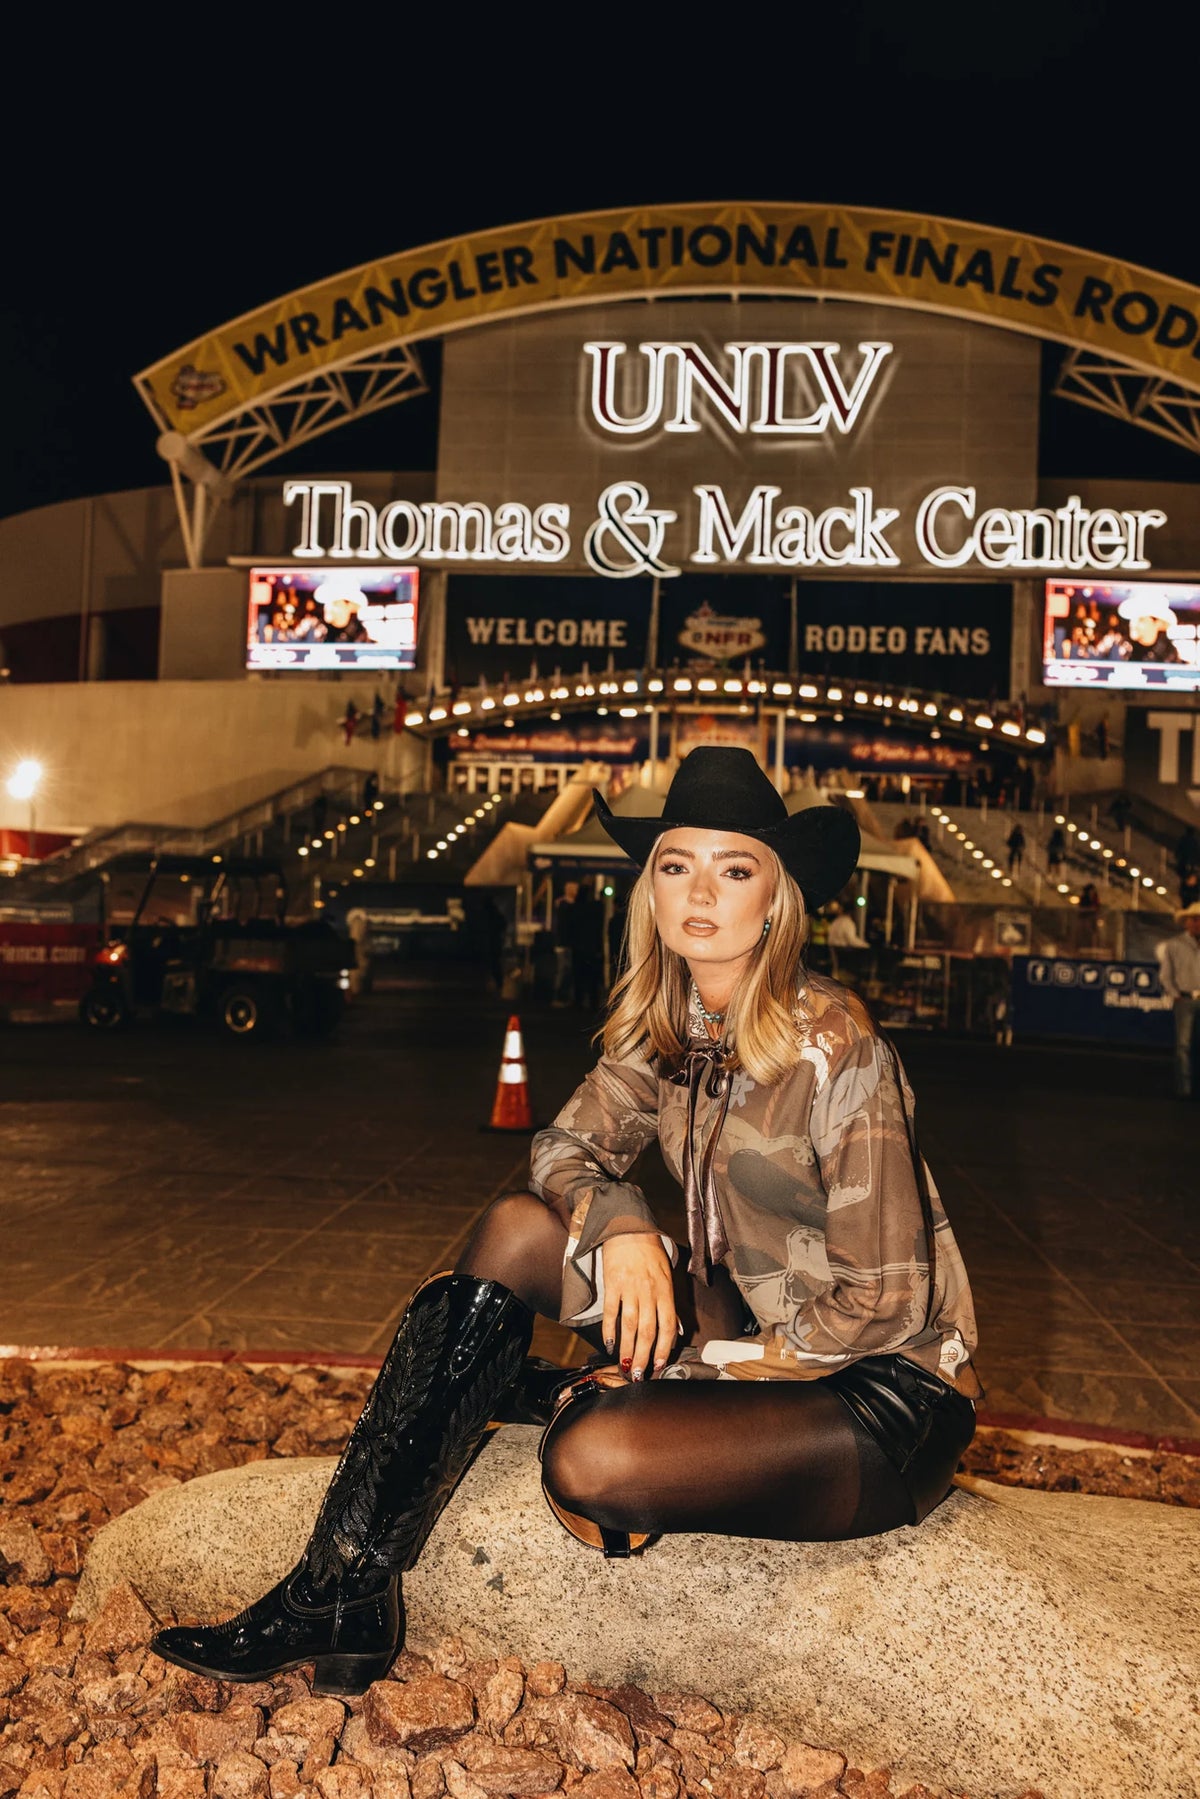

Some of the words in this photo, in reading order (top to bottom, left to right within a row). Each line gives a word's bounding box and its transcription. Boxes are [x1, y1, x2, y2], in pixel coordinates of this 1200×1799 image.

[233, 246, 539, 376] WRANGLER
[553, 224, 848, 279] NATIONAL
[864, 231, 1064, 307] FINALS
[583, 341, 894, 434] UNLV
[283, 480, 571, 563] Thomas
[583, 481, 682, 578] &
[690, 485, 900, 566] Mack
[915, 485, 1168, 570] Center
[466, 616, 628, 647] WELCOME
[804, 624, 907, 655] RODEO
[915, 626, 990, 656] FANS
